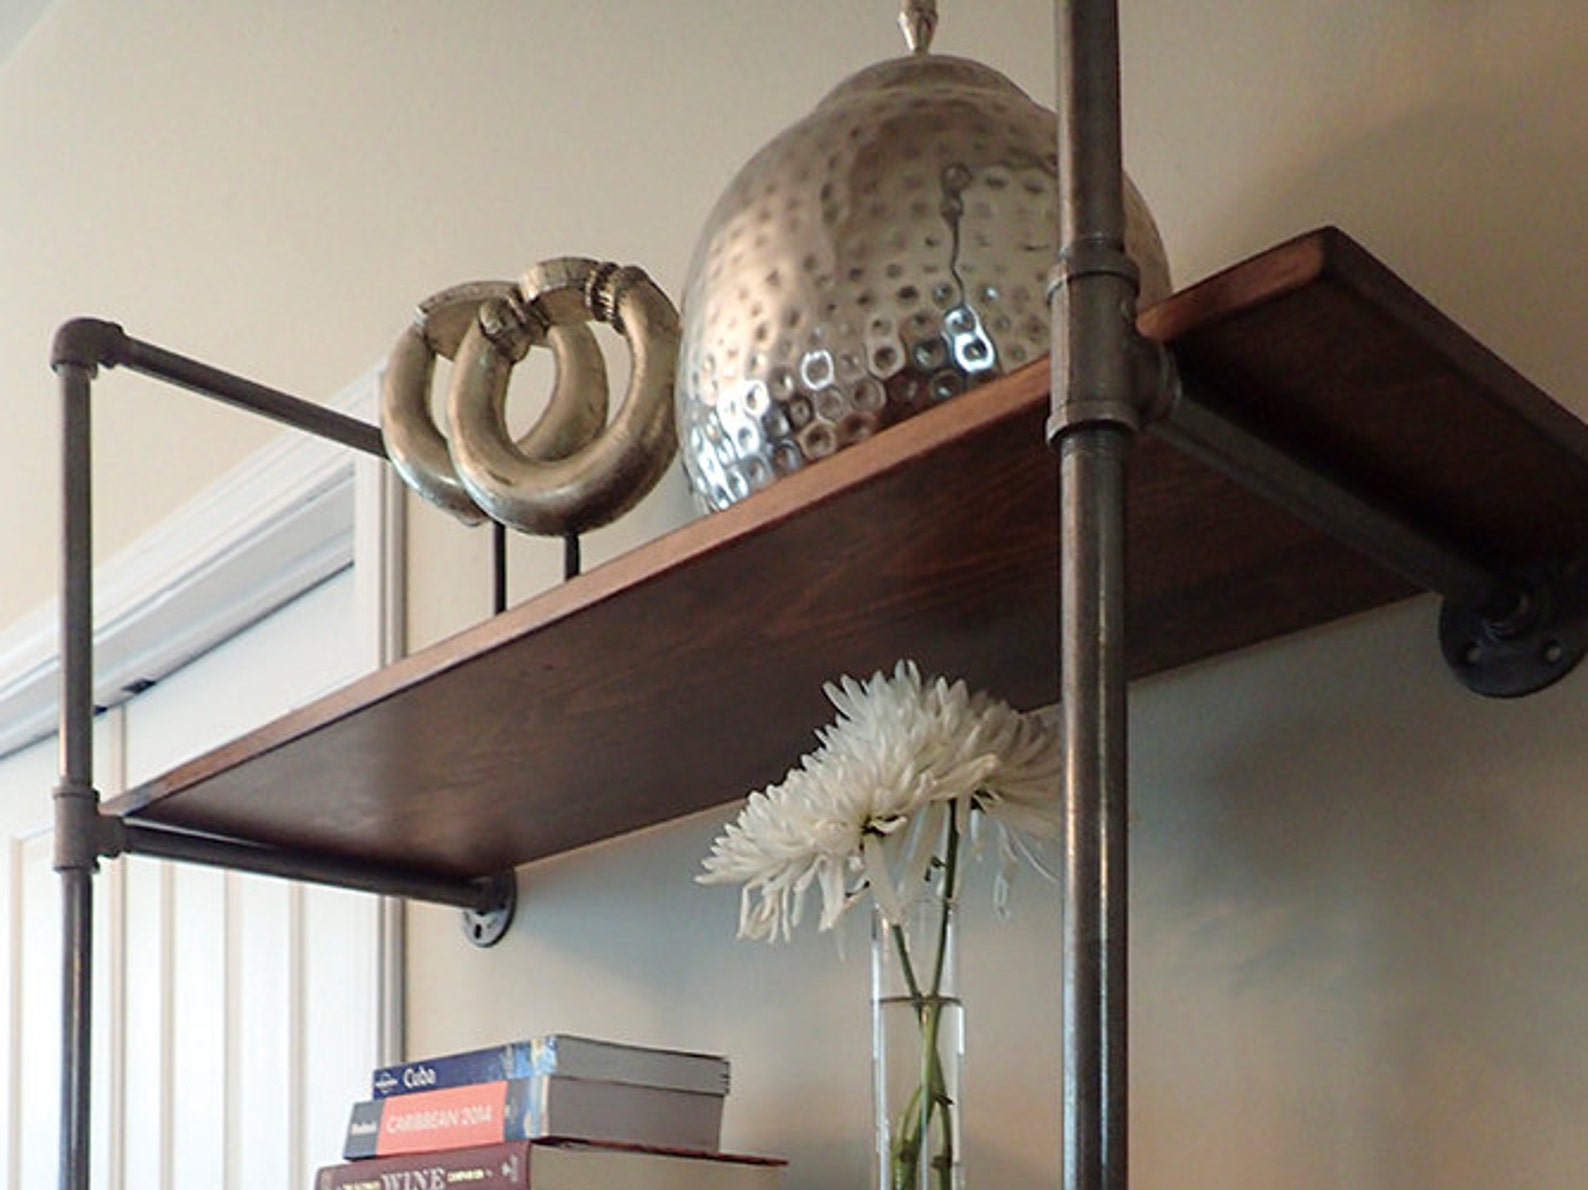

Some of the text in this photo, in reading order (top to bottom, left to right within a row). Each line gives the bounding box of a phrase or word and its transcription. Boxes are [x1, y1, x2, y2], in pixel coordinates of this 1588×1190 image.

[403, 1065, 437, 1088] Cuba
[385, 1108, 458, 1135] CARIBBEAN
[460, 1104, 493, 1126] 2014
